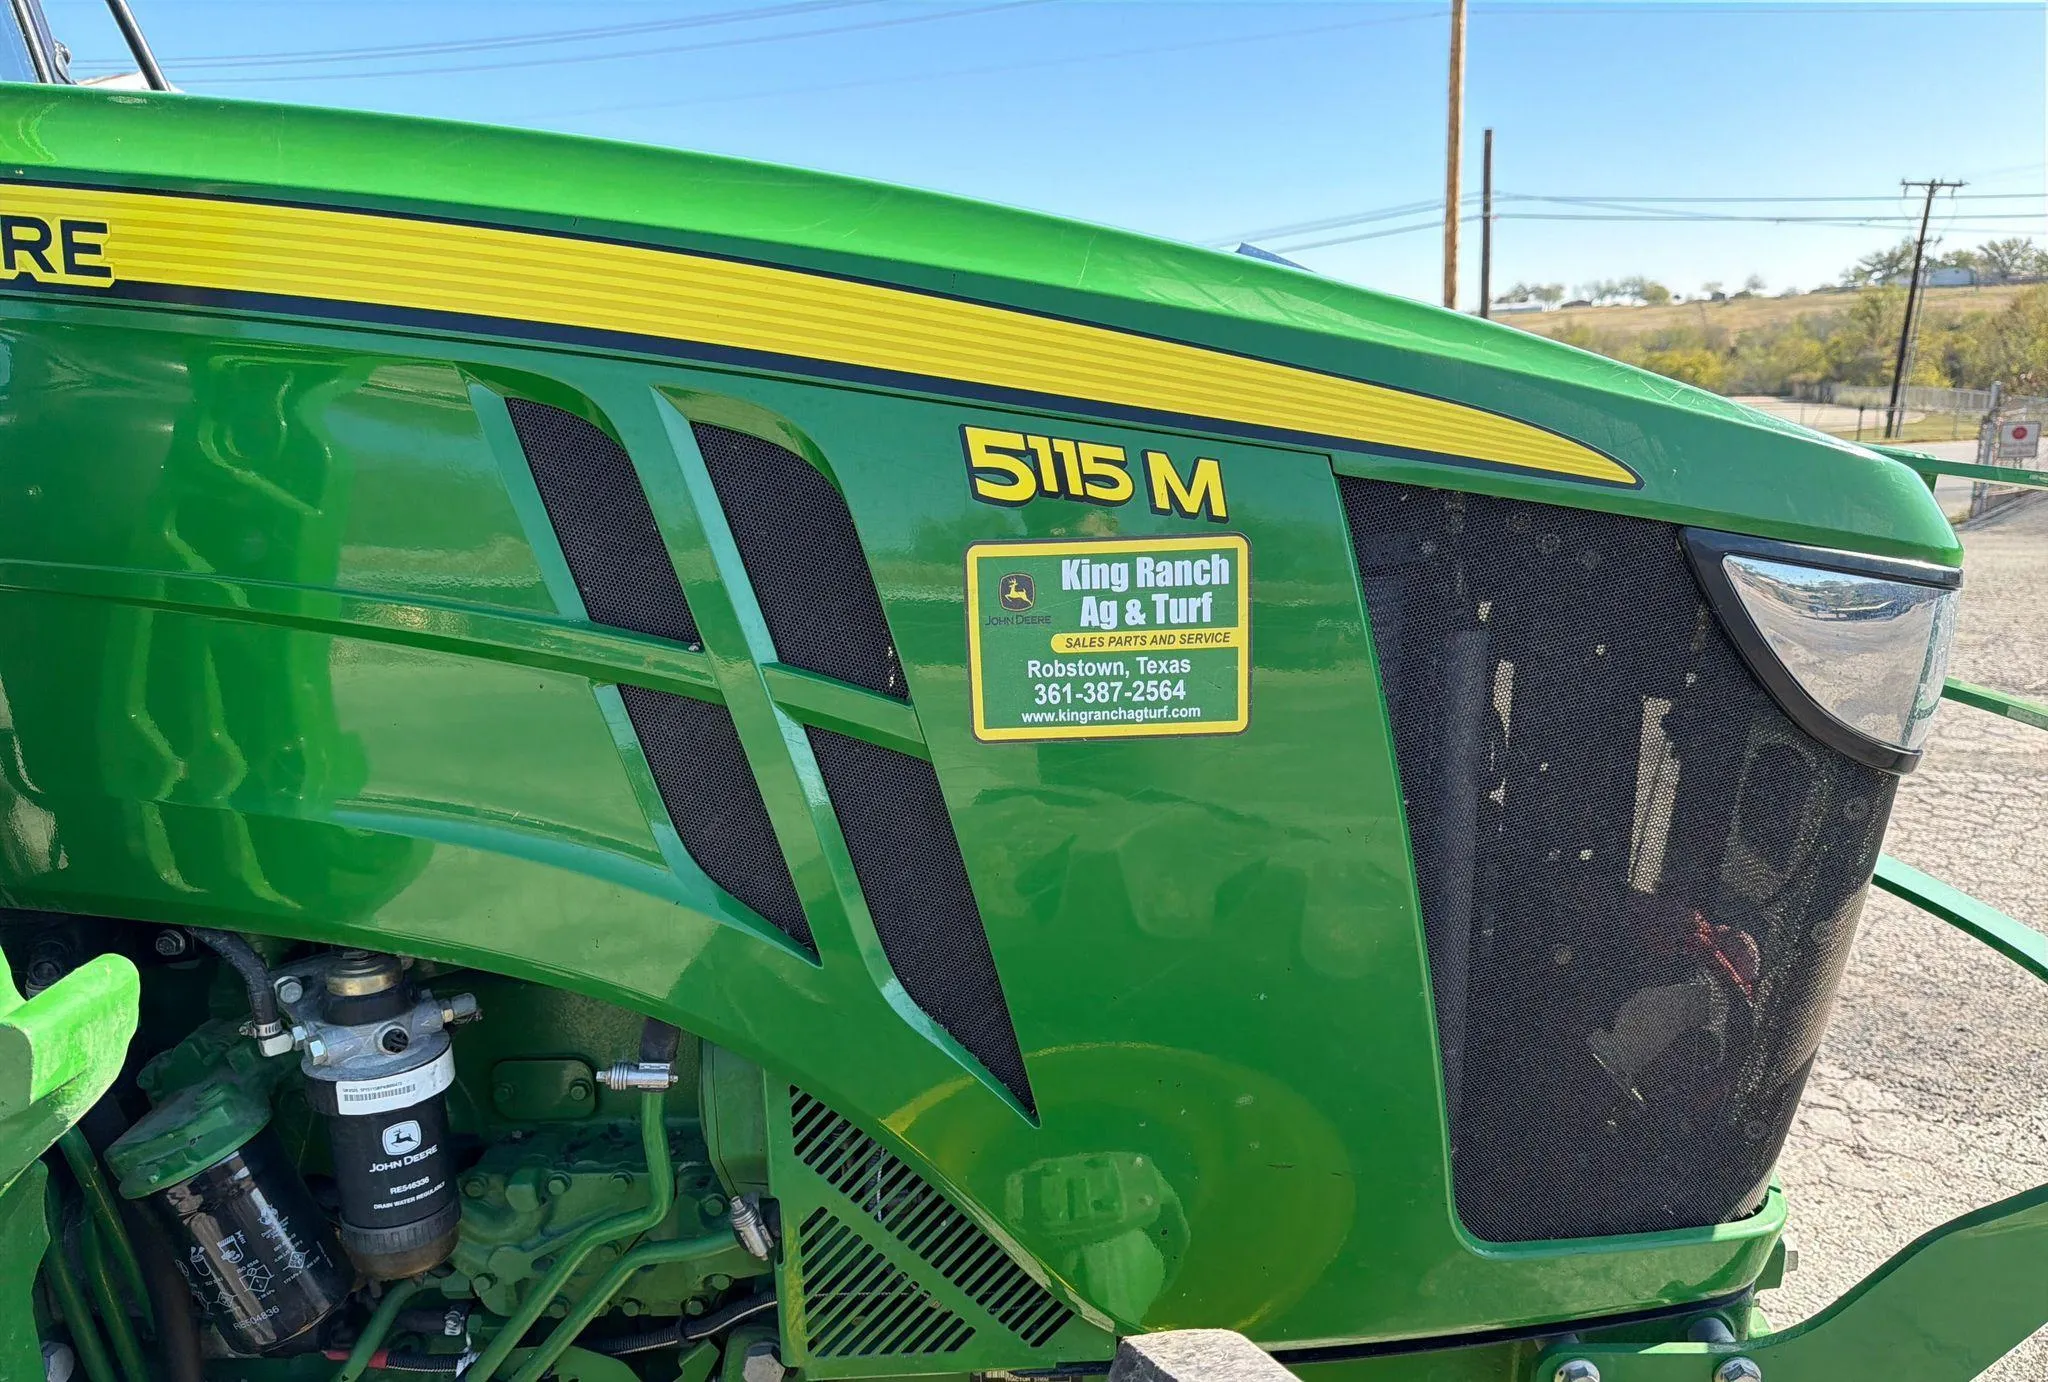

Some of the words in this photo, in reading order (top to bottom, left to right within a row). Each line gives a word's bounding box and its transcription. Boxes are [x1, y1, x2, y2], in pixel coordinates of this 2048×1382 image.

[0, 214, 113, 279] RE
[959, 424, 1135, 507] 5115
[1141, 449, 1230, 524] M
[1061, 559, 1129, 592] King
[1136, 554, 1230, 588] Ranch
[985, 615, 1014, 626] JOHN
[1015, 615, 1052, 625] DEERE
[1080, 596, 1118, 630] Ag
[1125, 599, 1146, 626] &
[1152, 592, 1213, 625] Turf
[1065, 636, 1105, 649] SALES
[1108, 634, 1148, 648] PARTS
[1149, 633, 1176, 646] AND
[1178, 632, 1231, 645] SERVICE
[1027, 658, 1130, 679] Robstown,
[1136, 656, 1191, 675] Texas
[1034, 679, 1187, 706] 361-387-2564
[1021, 706, 1202, 724] www.kingranchagturf.com
[369, 1159, 403, 1173] JOHN
[403, 1145, 438, 1167] DEERE
[232, 1305, 280, 1330] RE504836
